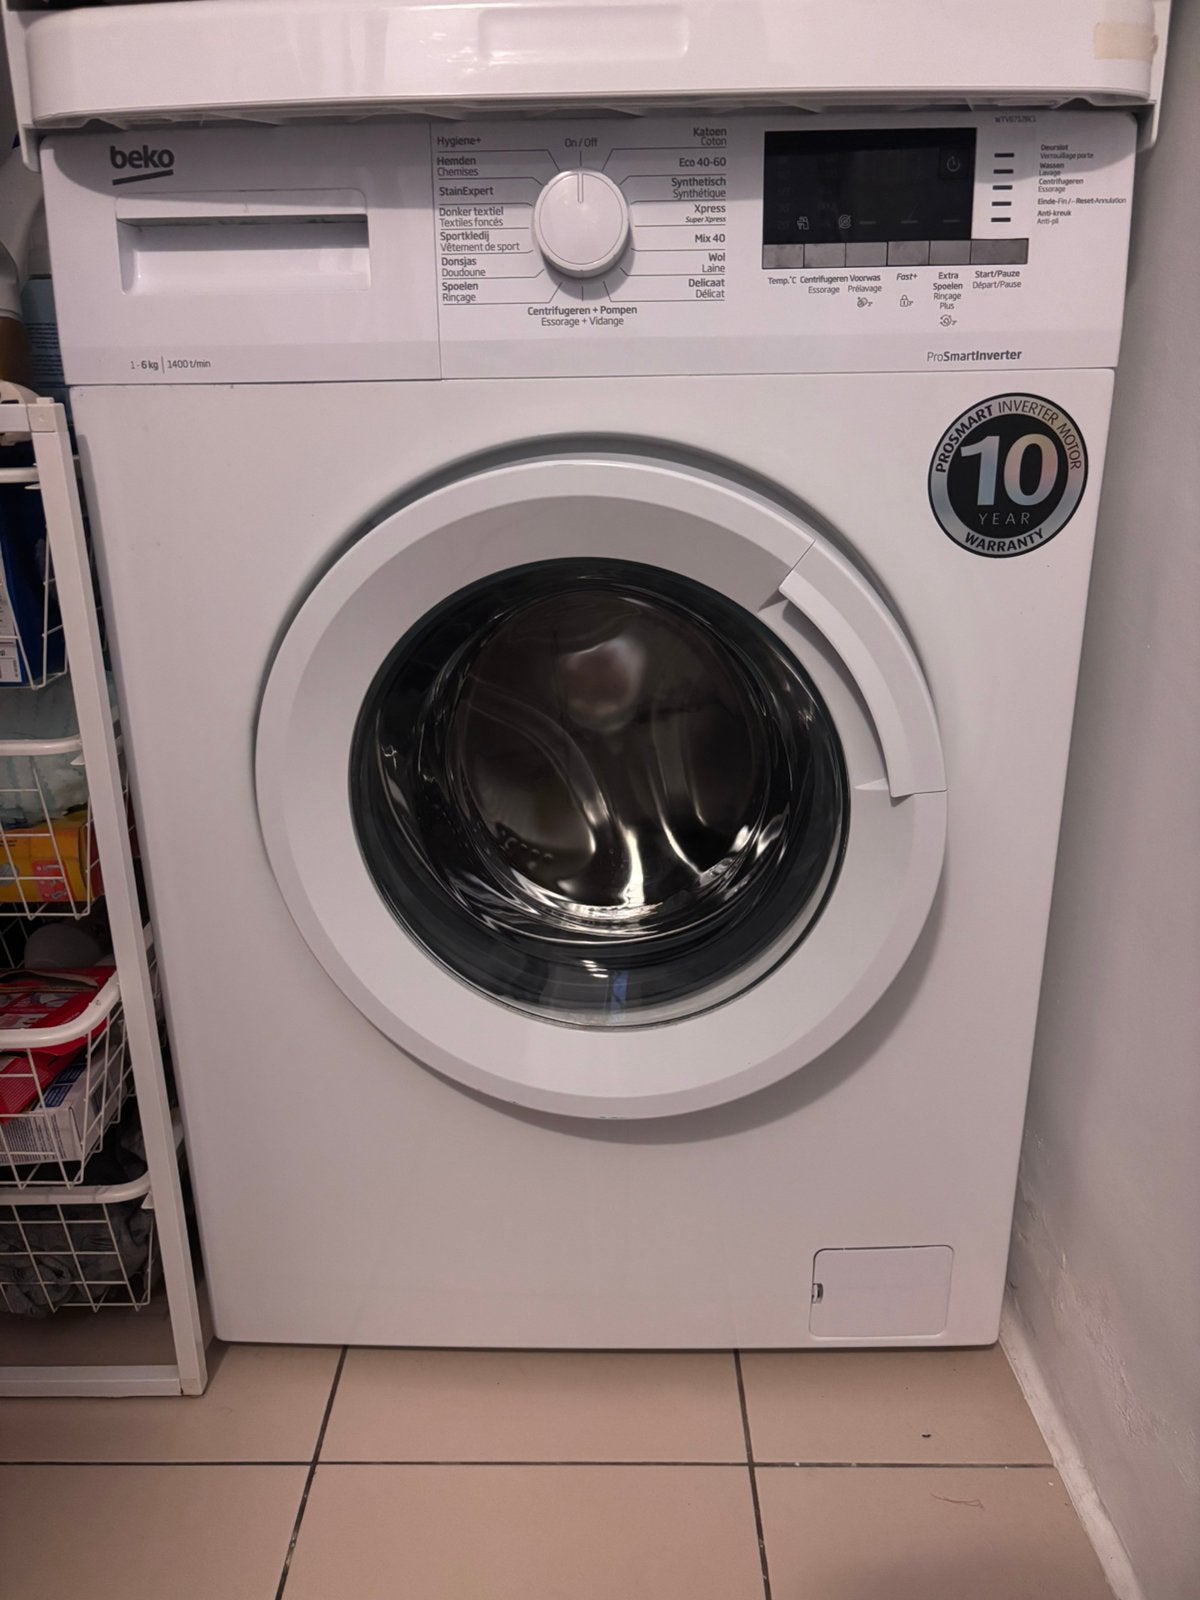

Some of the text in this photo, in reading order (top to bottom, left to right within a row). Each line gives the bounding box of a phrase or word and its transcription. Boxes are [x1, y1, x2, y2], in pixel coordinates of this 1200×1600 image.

[693, 127, 727, 137] Katoen
[437, 136, 481, 148] Hygiene+
[564, 138, 577, 147] On
[584, 137, 598, 147] Off
[700, 137, 727, 146] Coton
[109, 145, 175, 169] beko
[437, 157, 476, 165] Hemden
[1040, 152, 1076, 160] Verrouillage
[679, 157, 727, 167] Eco 40-60
[437, 167, 479, 176] Chemises
[671, 177, 727, 189] Synthetisch
[1038, 178, 1084, 186] Centrifugeren
[439, 186, 494, 197] StainExpert
[673, 188, 727, 200] Synthétique
[439, 206, 504, 216] Donker textiel
[694, 204, 726, 215] Xpress
[440, 218, 503, 227] Textiles foncés
[685, 216, 726, 224] Super Xpress
[440, 231, 490, 242] Sportkledij
[695, 234, 726, 243] Mix 40
[441, 242, 520, 252] Vêtement de sport
[441, 257, 477, 267] Donsjas
[708, 253, 726, 262] Wol
[442, 268, 486, 277] Doudoune
[702, 264, 726, 273] Laine
[800, 273, 849, 284] Centrifugeren
[850, 273, 881, 282] Voorwas
[896, 272, 918, 281] Fast+
[938, 271, 959, 279] Extra
[975, 269, 1020, 279] Start/Pauze
[442, 282, 479, 292] Spoelen
[688, 278, 725, 288] Delicaat
[933, 281, 963, 291] Spoelen
[972, 279, 1022, 289] Départ/Pause
[695, 289, 725, 298] Délicat
[808, 286, 840, 295] Essorage
[848, 284, 882, 294] Prélavage
[442, 293, 476, 304] Rinçage
[933, 292, 962, 302] Rinçage
[940, 302, 955, 310] Plus
[527, 306, 591, 317] Centrifugeren
[600, 306, 638, 317] Pompen
[541, 317, 580, 328] Essorage
[589, 317, 624, 327] Vidange
[927, 350, 1023, 363] ProSmartInverter
[167, 360, 189, 369] 1400
[935, 399, 1082, 473] PROSMART INVERTER MOTOR
[960, 433, 1059, 506] 10
[978, 512, 1031, 525] YEAR
[964, 527, 1046, 552] WARRANTY
